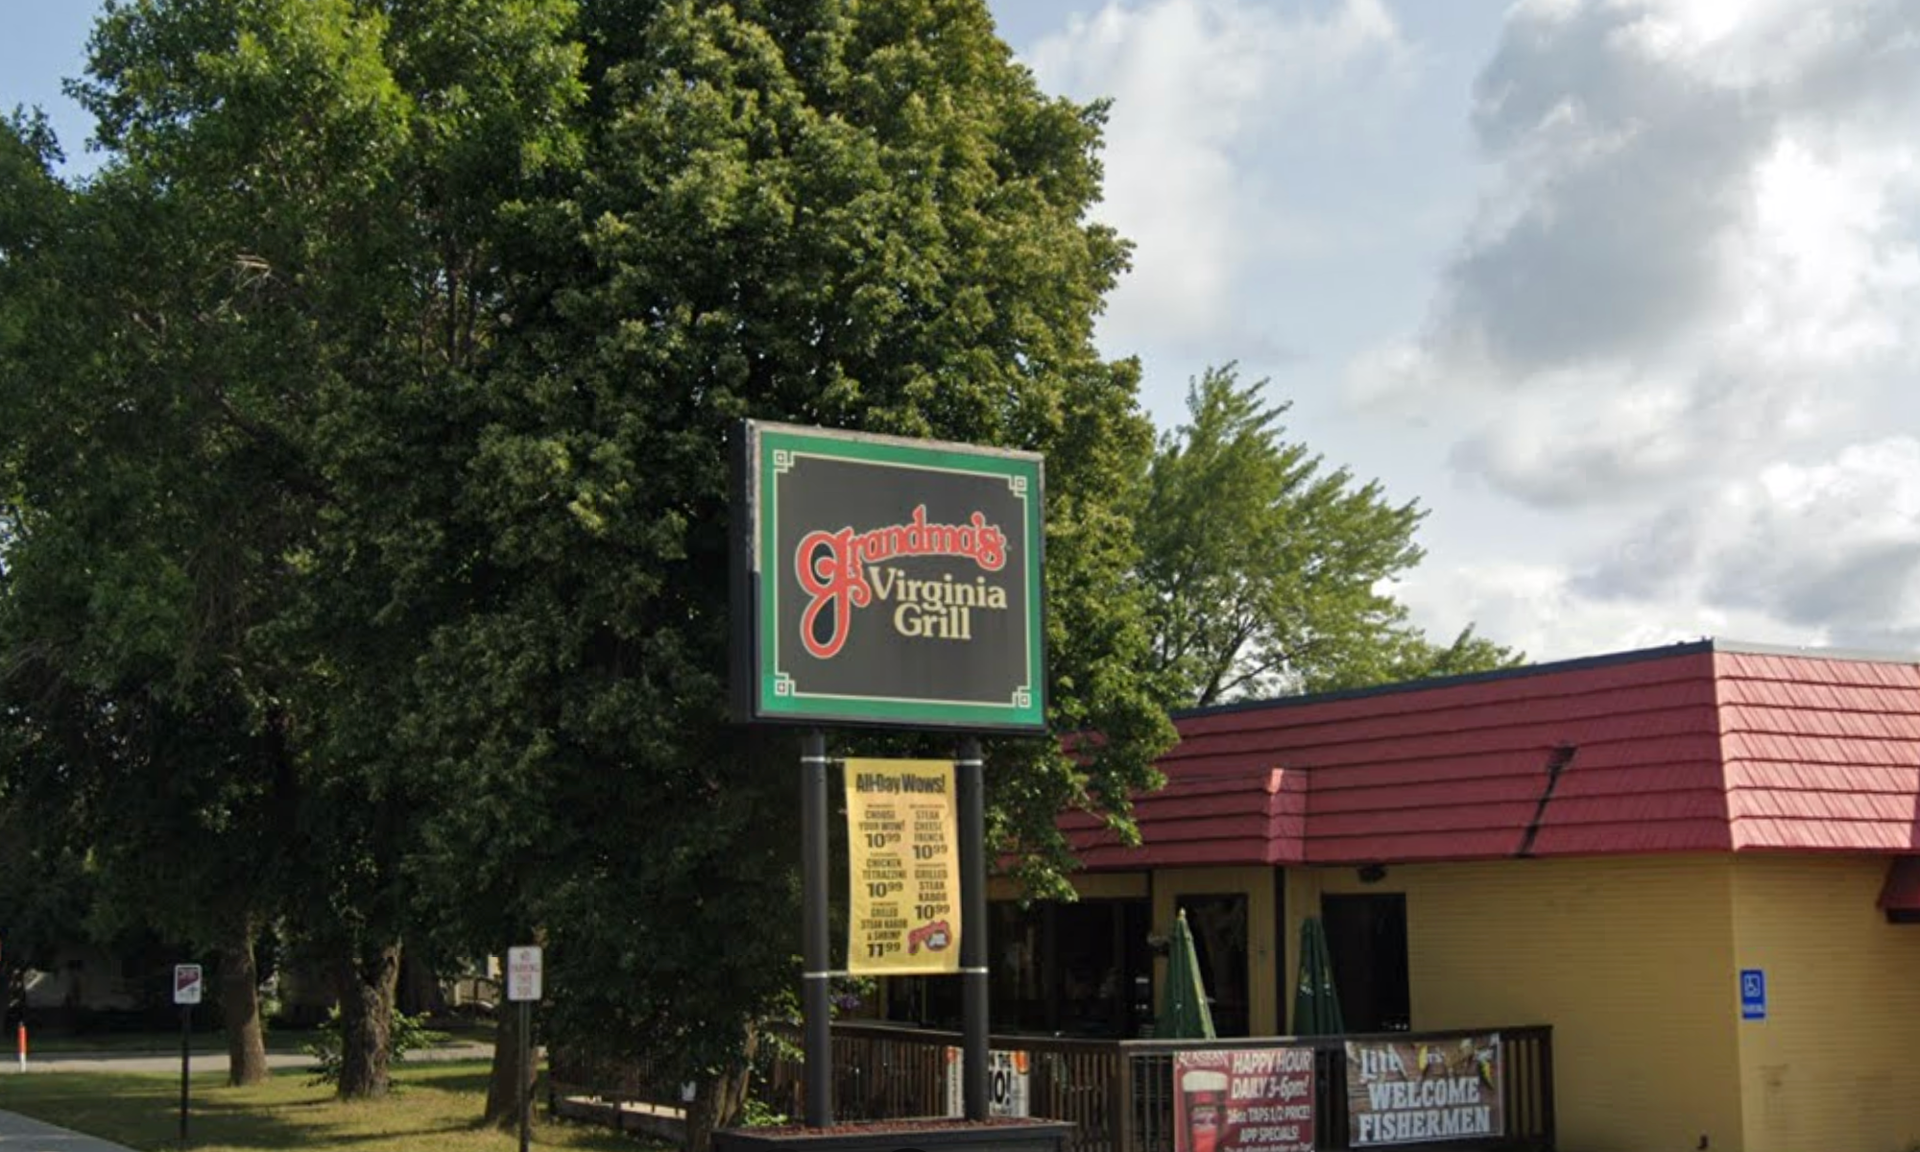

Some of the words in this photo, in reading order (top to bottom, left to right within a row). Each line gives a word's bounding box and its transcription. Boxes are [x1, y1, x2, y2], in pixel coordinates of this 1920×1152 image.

[868, 566, 1007, 611] Virginia
[893, 602, 971, 640] Grill
[856, 773, 900, 795] All-Day
[901, 773, 946, 794] Wows!
[1231, 1052, 1278, 1074] HAPPY
[1276, 1050, 1313, 1073] HOUR
[1231, 1077, 1269, 1099] DAILY
[1268, 1075, 1310, 1102] 3-6pm!
[1368, 1076, 1480, 1111] WELCOME
[1359, 1106, 1491, 1142] FISHERMEN
